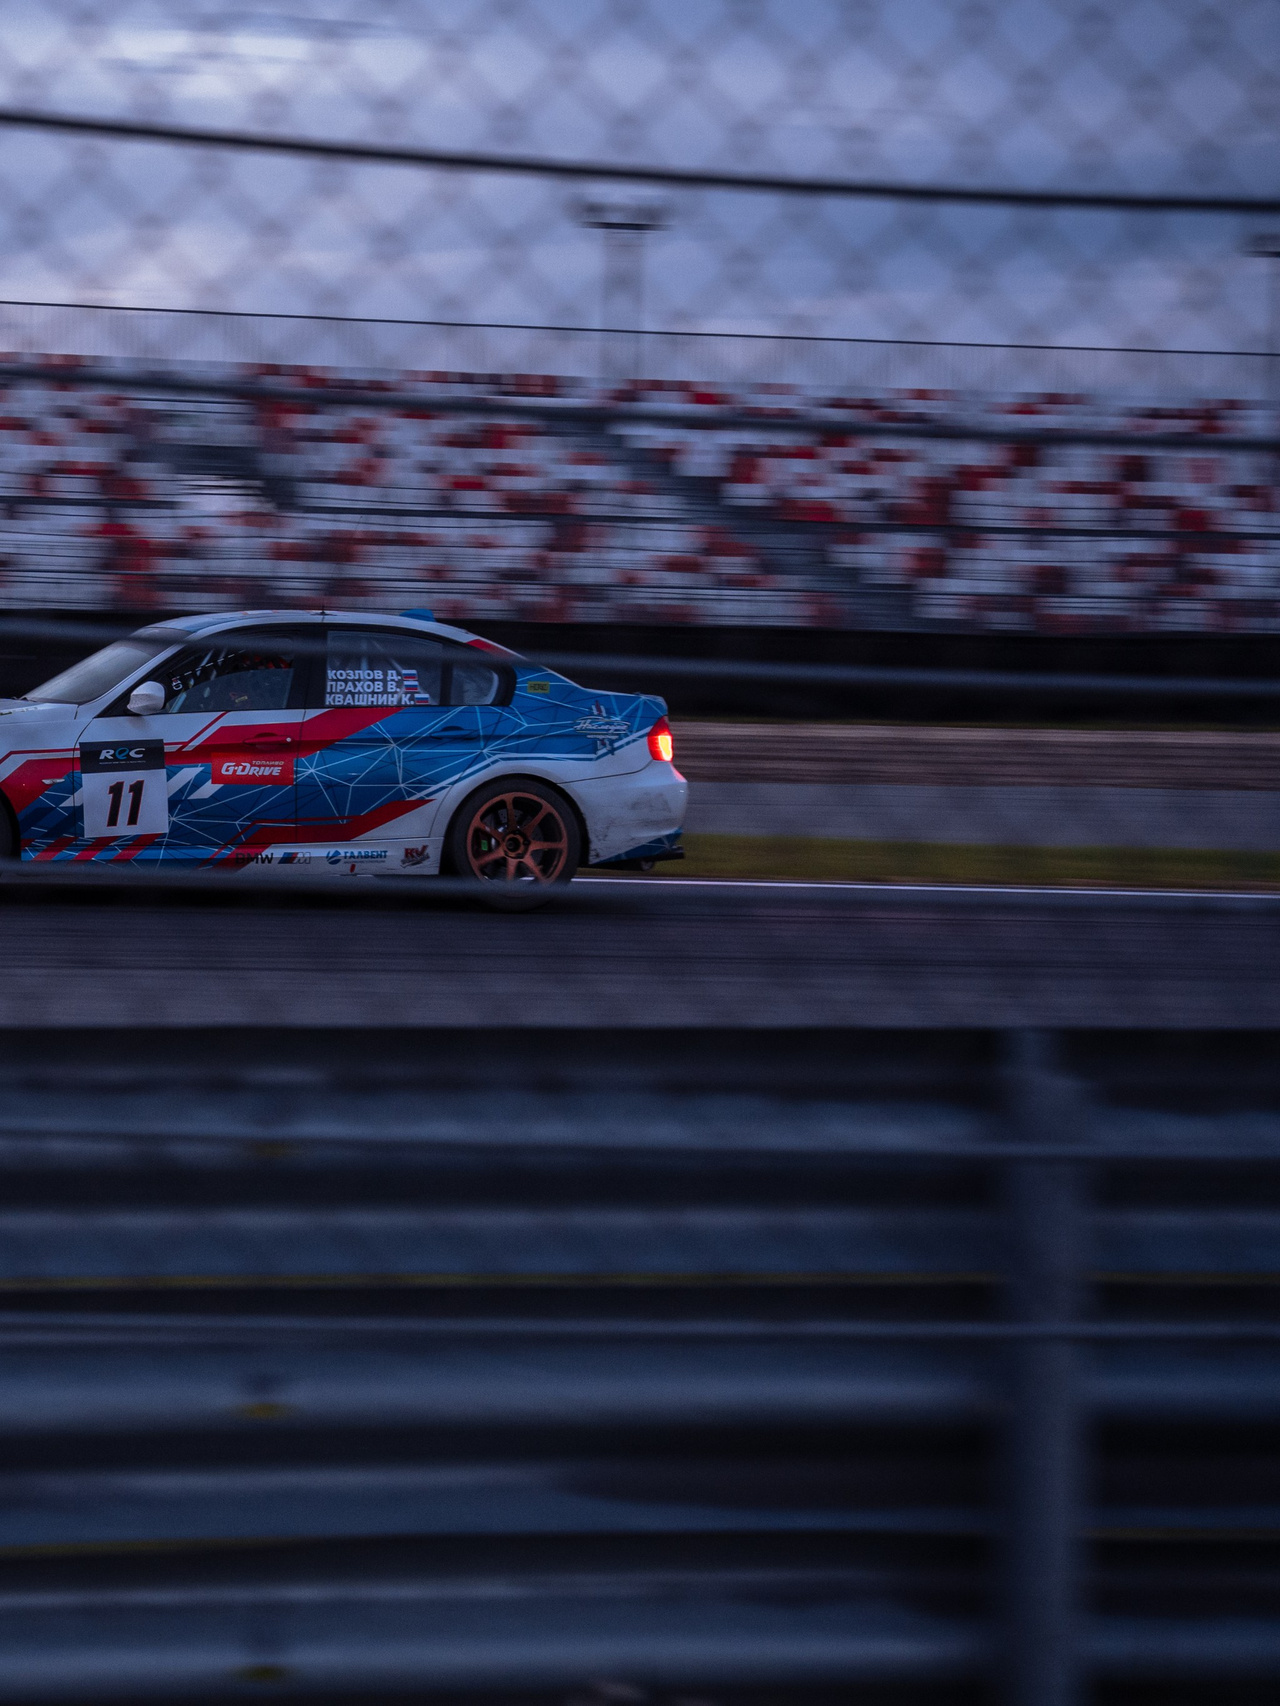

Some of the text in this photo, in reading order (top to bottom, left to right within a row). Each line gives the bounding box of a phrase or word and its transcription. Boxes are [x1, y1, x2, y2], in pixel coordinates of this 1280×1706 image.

[327, 670, 401, 681] КОЗЛОВ Д.
[327, 682, 400, 692] ПРАХОВ В.
[325, 694, 414, 705] КВАШНИН К.
[106, 780, 144, 828] 11
[235, 852, 273, 864] BMW
[343, 850, 388, 860] ГАЛВЕНТ
